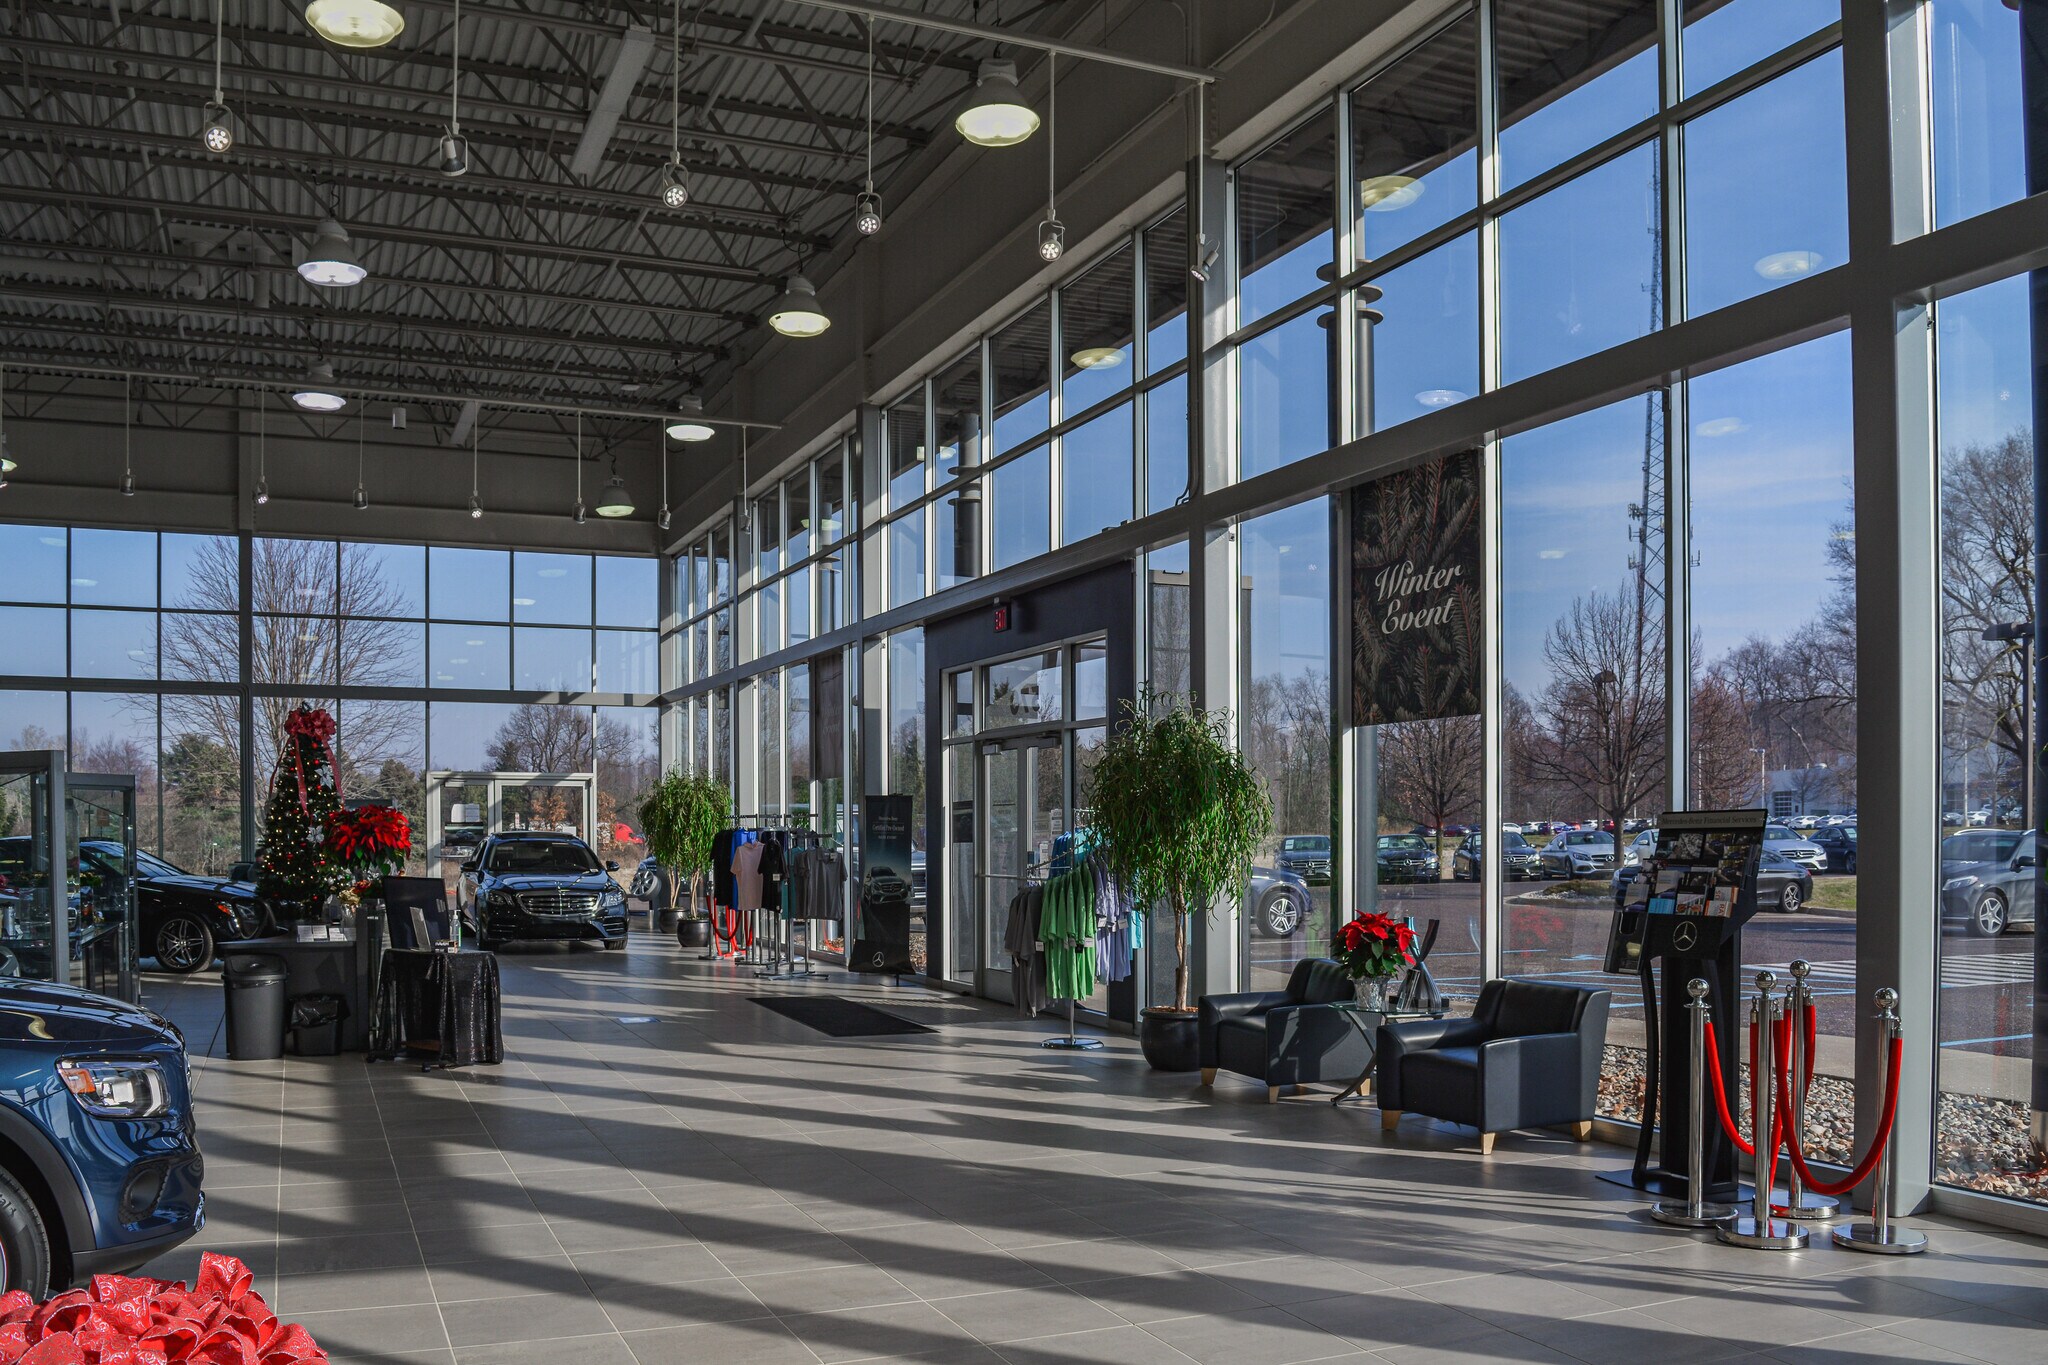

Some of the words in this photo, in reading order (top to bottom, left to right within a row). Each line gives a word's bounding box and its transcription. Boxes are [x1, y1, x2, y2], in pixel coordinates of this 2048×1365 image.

[1375, 560, 1464, 602] Winter
[1381, 596, 1456, 635] Event
[1704, 816, 1731, 825] Financial
[1732, 815, 1757, 824] Services
